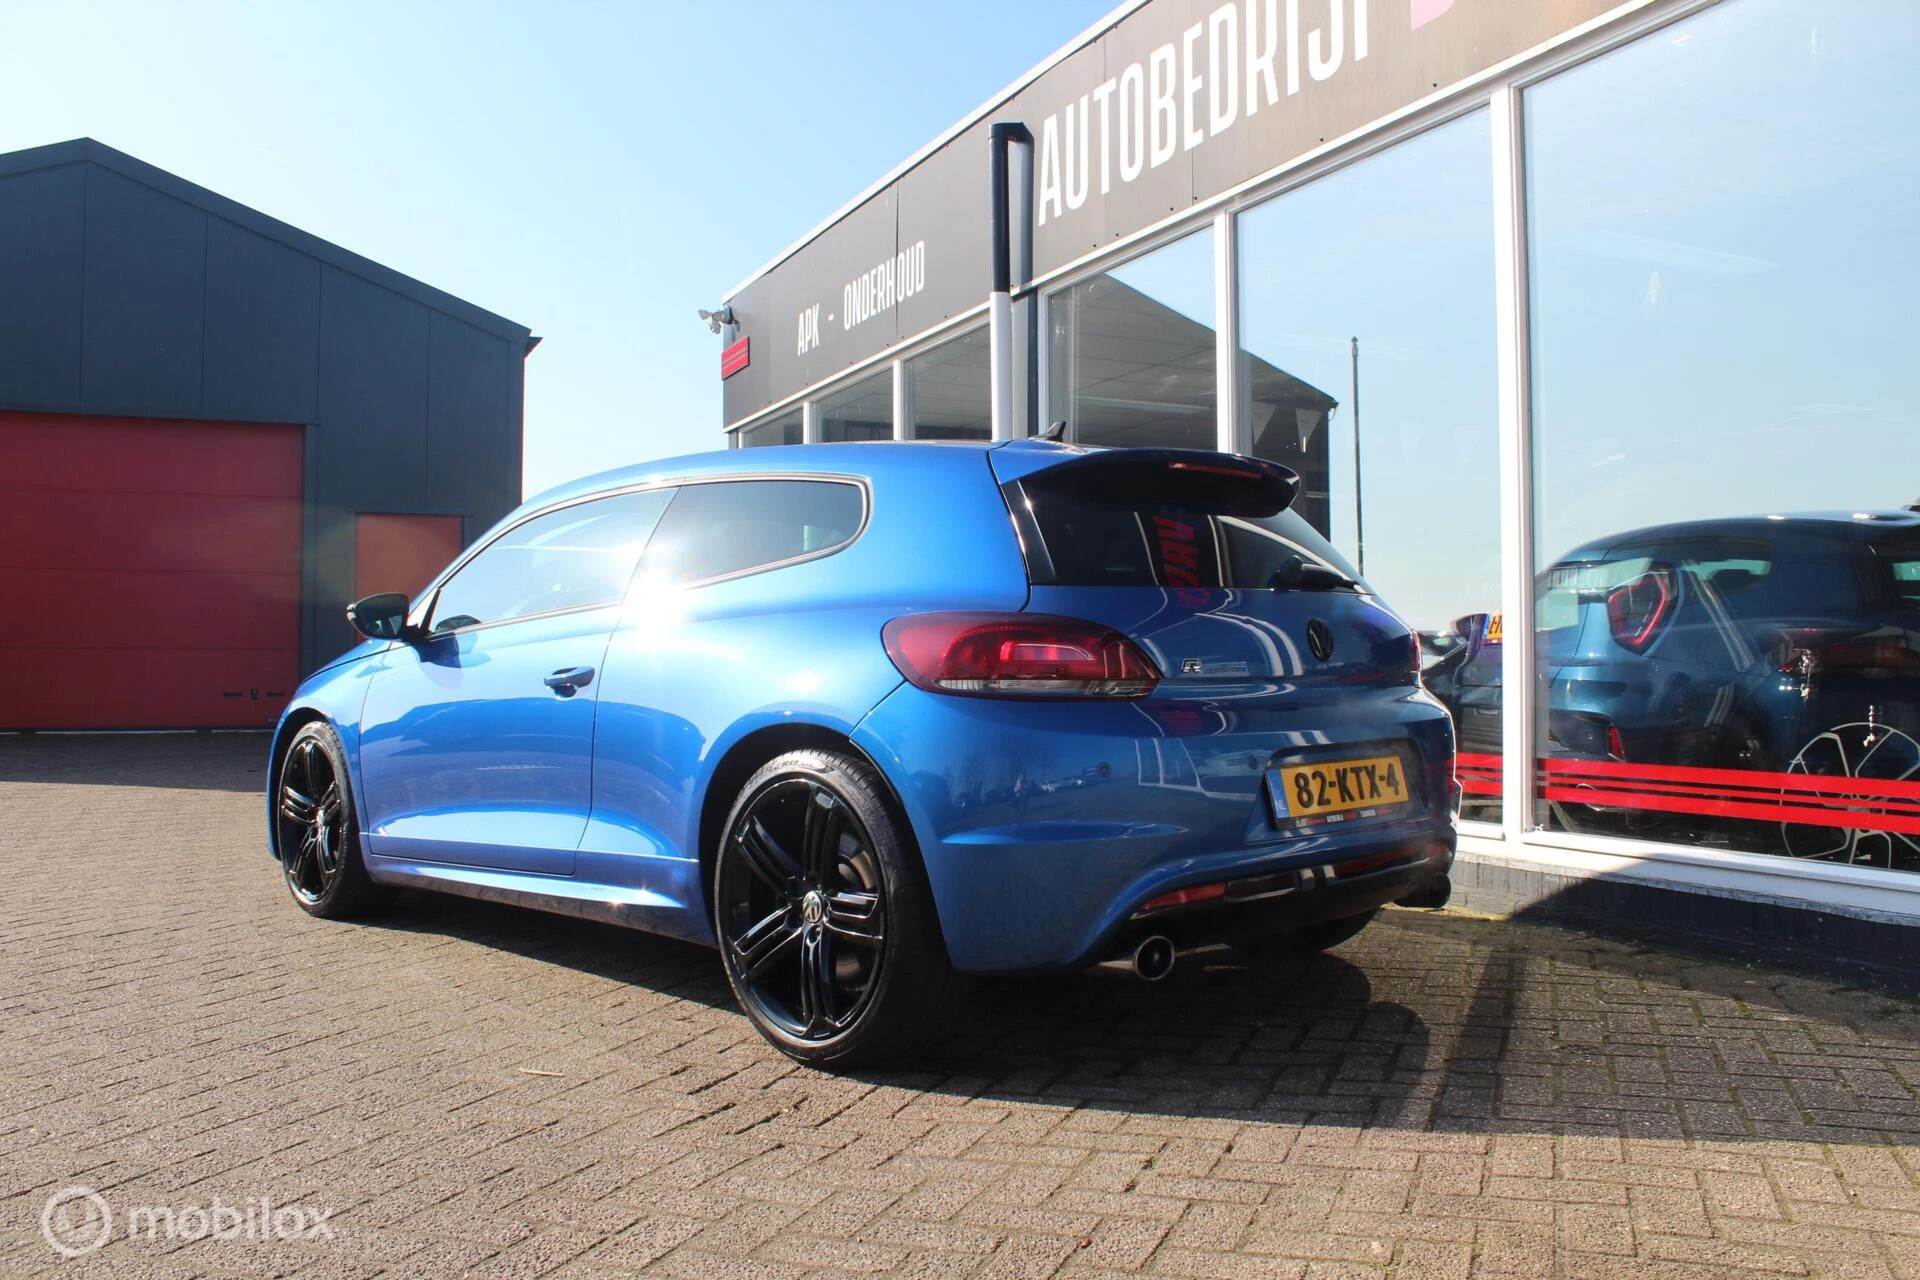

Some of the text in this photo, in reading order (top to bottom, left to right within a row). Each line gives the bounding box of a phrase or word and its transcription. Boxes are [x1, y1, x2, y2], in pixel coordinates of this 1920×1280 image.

[797, 302, 820, 356] APK
[843, 241, 925, 331] ONDERHOUD
[1274, 799, 1287, 811] NL
[1294, 763, 1400, 809] 82-KTX-4
